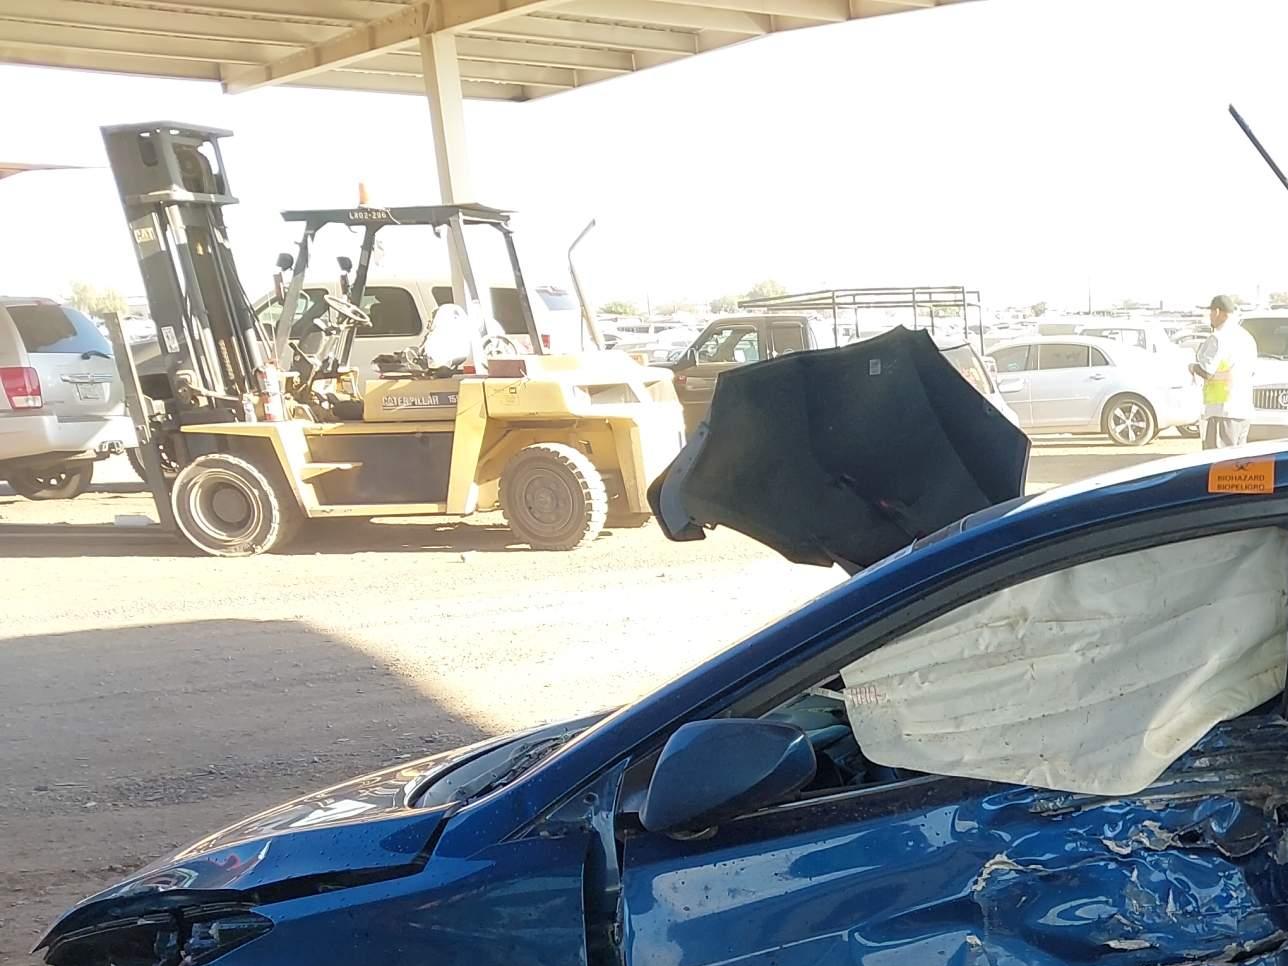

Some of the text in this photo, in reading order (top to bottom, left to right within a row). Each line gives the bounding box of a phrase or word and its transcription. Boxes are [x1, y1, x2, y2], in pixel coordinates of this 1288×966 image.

[383, 394, 439, 406] CATERPILLAR
[1217, 474, 1265, 482] BIOHAZARD
[1216, 483, 1265, 492] BIOPELIGRO
